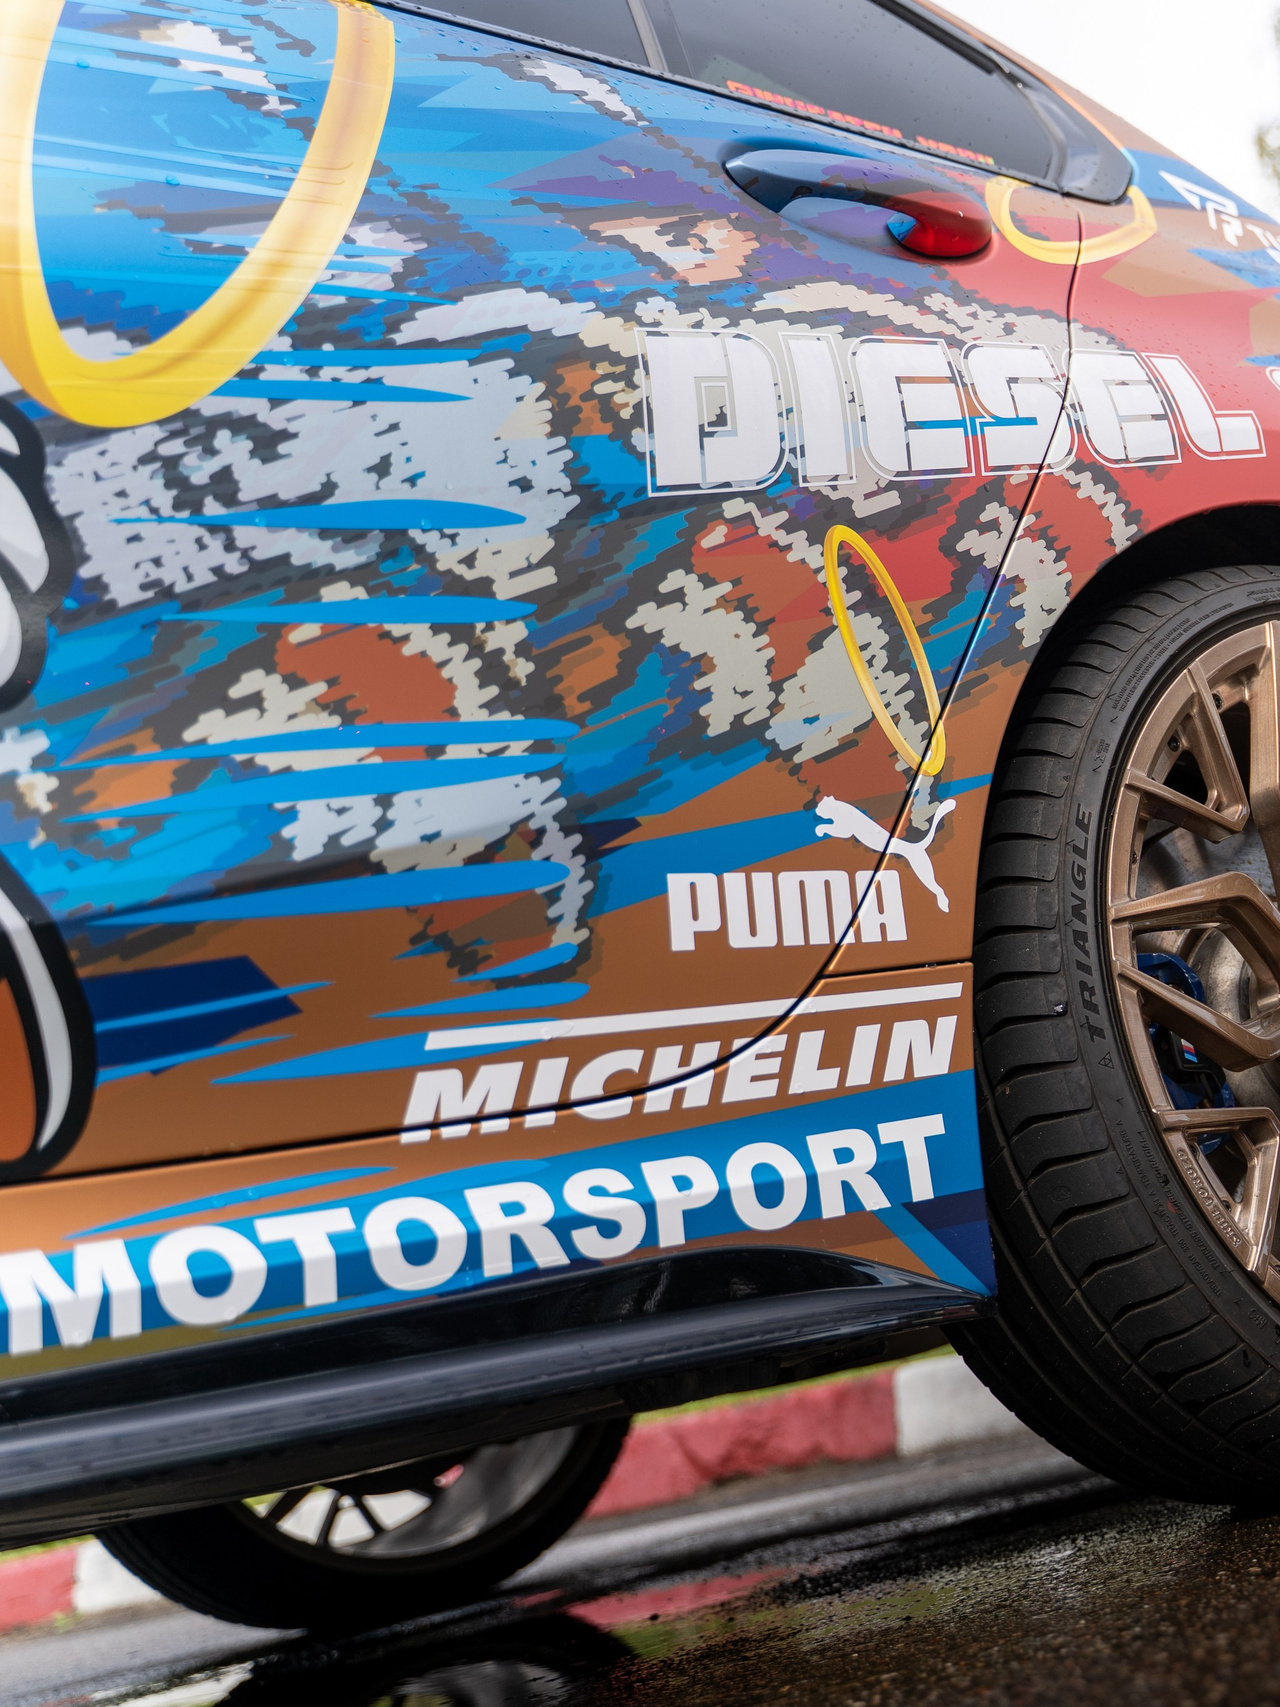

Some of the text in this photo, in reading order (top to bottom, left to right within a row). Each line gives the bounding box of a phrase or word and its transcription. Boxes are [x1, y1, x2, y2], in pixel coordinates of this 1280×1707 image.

[634, 328, 1267, 498] DIESEL
[667, 870, 908, 951] PUMA
[1066, 803, 1106, 1043] TRIANGLE
[400, 1016, 957, 1145] MICHELIN
[1118, 1127, 1151, 1189] TEMPERATURE
[1177, 1148, 1215, 1207] FORGED
[0, 1113, 946, 1355] MOTORSPORT
